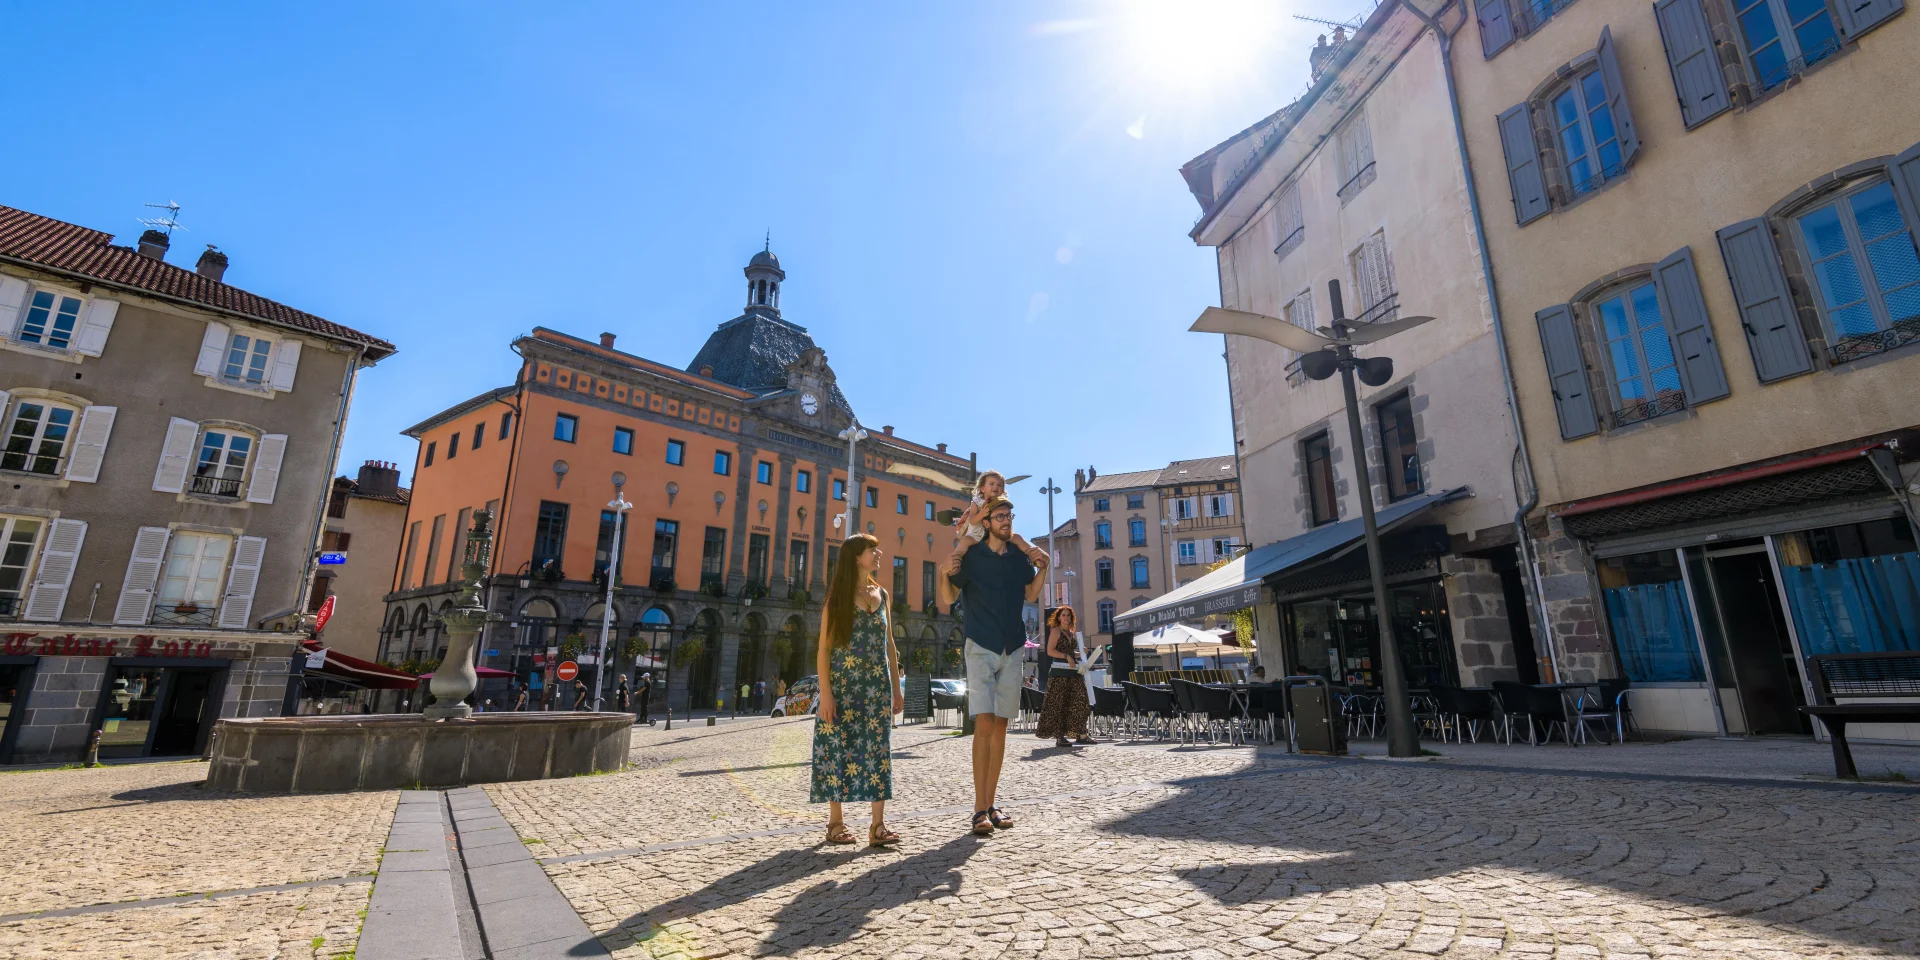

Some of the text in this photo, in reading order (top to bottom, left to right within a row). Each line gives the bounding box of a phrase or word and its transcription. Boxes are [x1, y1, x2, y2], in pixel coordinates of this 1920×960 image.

[316, 600, 331, 627] TABAC
[1149, 614, 1156, 624] Le
[1178, 606, 1195, 618] Thym
[1204, 594, 1236, 612] BRASSERIE
[134, 634, 211, 658] Loto
